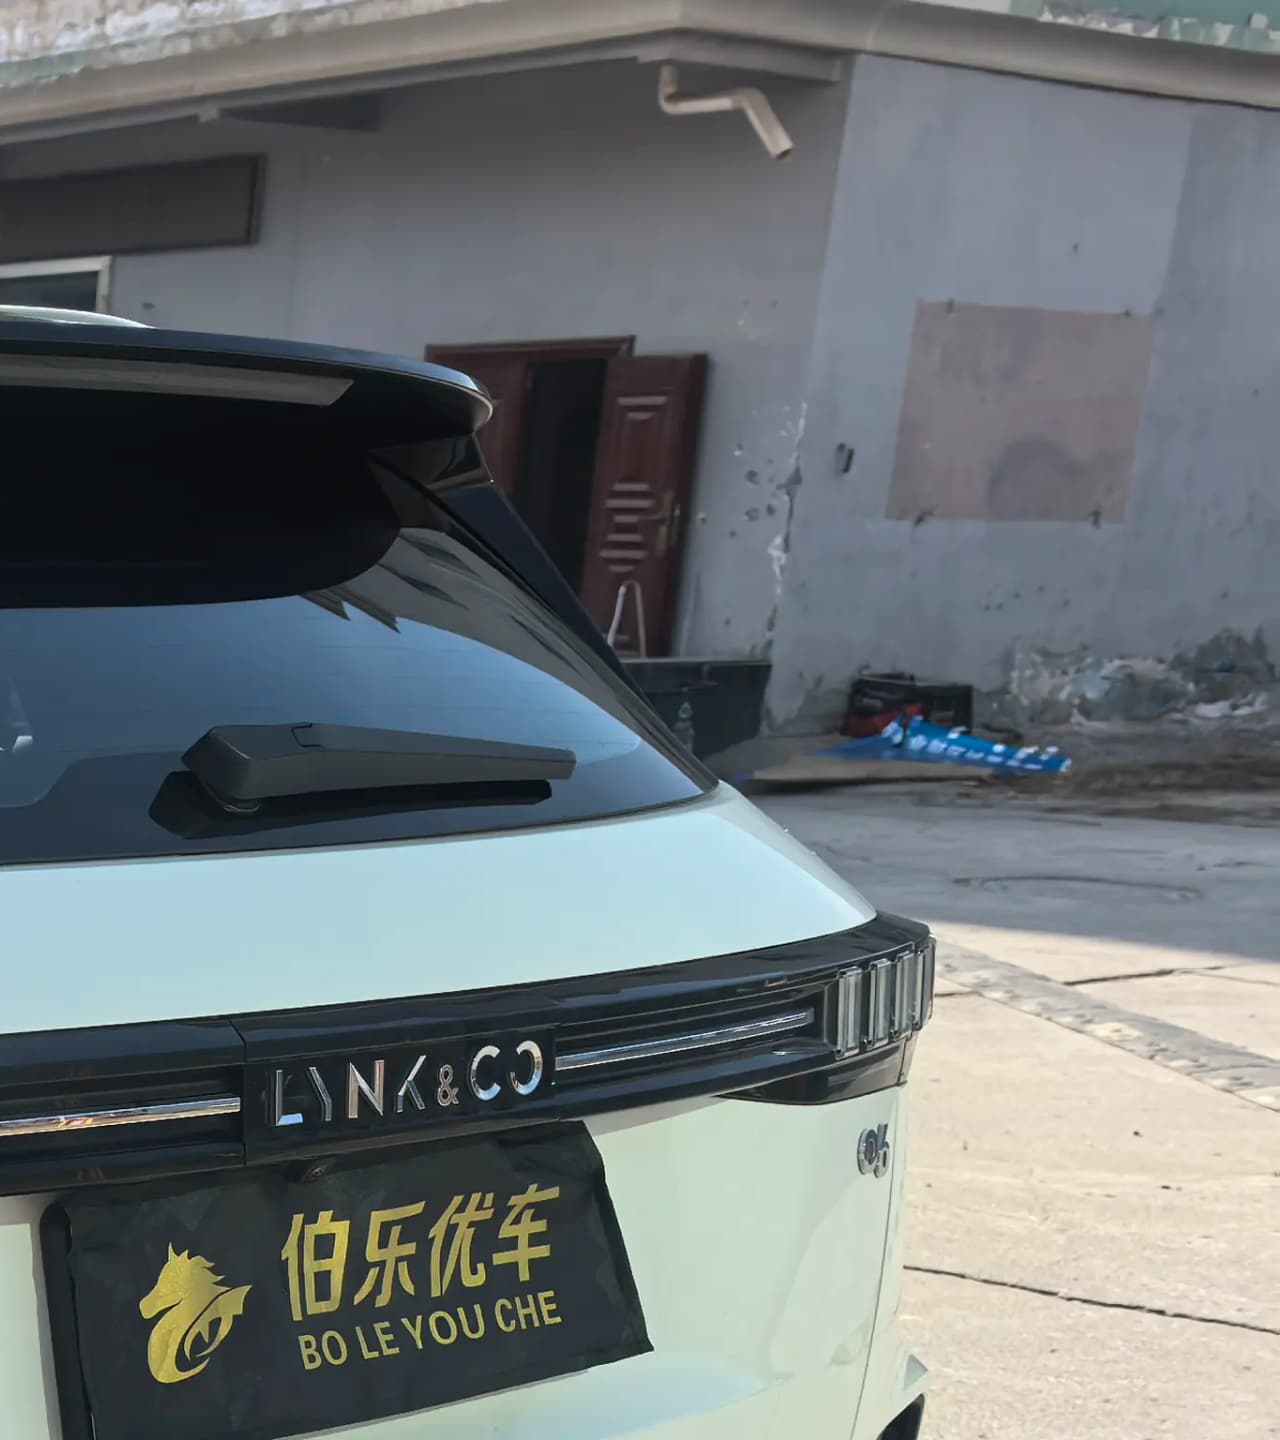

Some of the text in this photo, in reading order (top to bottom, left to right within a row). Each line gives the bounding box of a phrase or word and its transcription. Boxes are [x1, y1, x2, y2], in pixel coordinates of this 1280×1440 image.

[275, 1040, 544, 1126] LYNK&CO
[281, 1183, 560, 1322] 伯乐优车
[298, 1290, 562, 1370] BO LE YOU CHE
